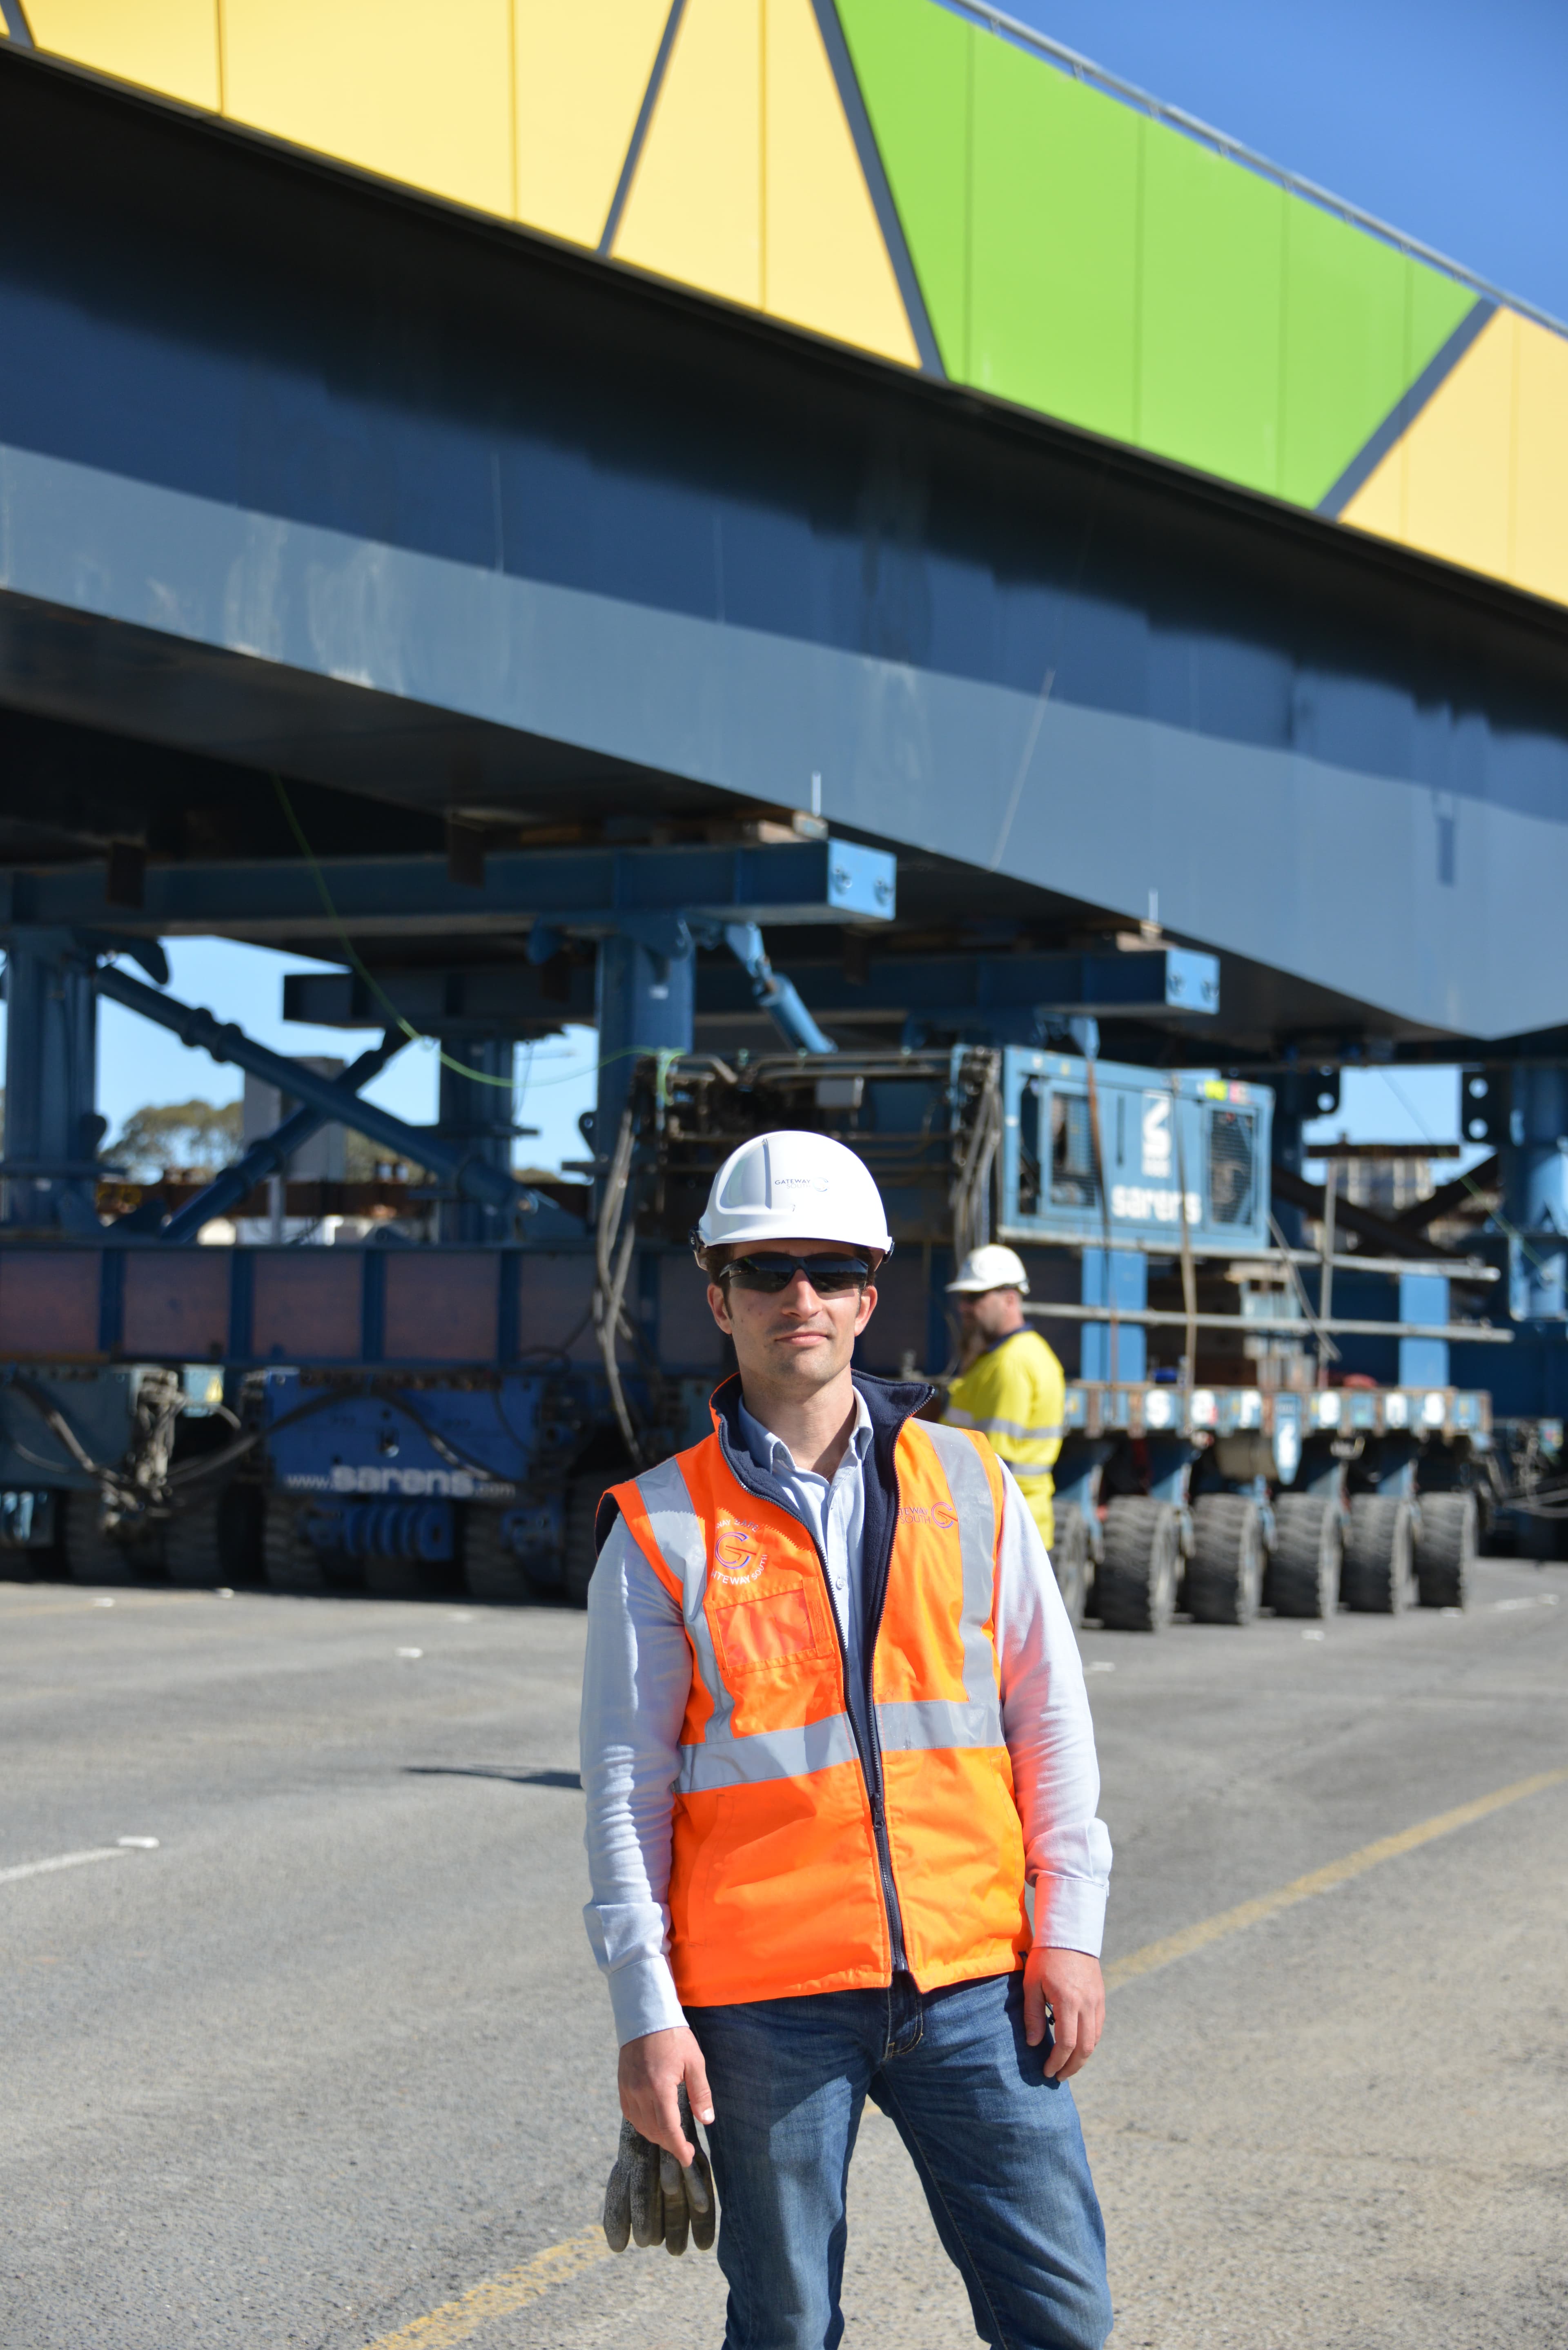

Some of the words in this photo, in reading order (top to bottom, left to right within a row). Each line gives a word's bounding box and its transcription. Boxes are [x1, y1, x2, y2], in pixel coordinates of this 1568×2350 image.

[734, 1518, 758, 1532] SAFE
[900, 1515, 931, 1524] SOUTH
[751, 1554, 768, 1580] SOUTH
